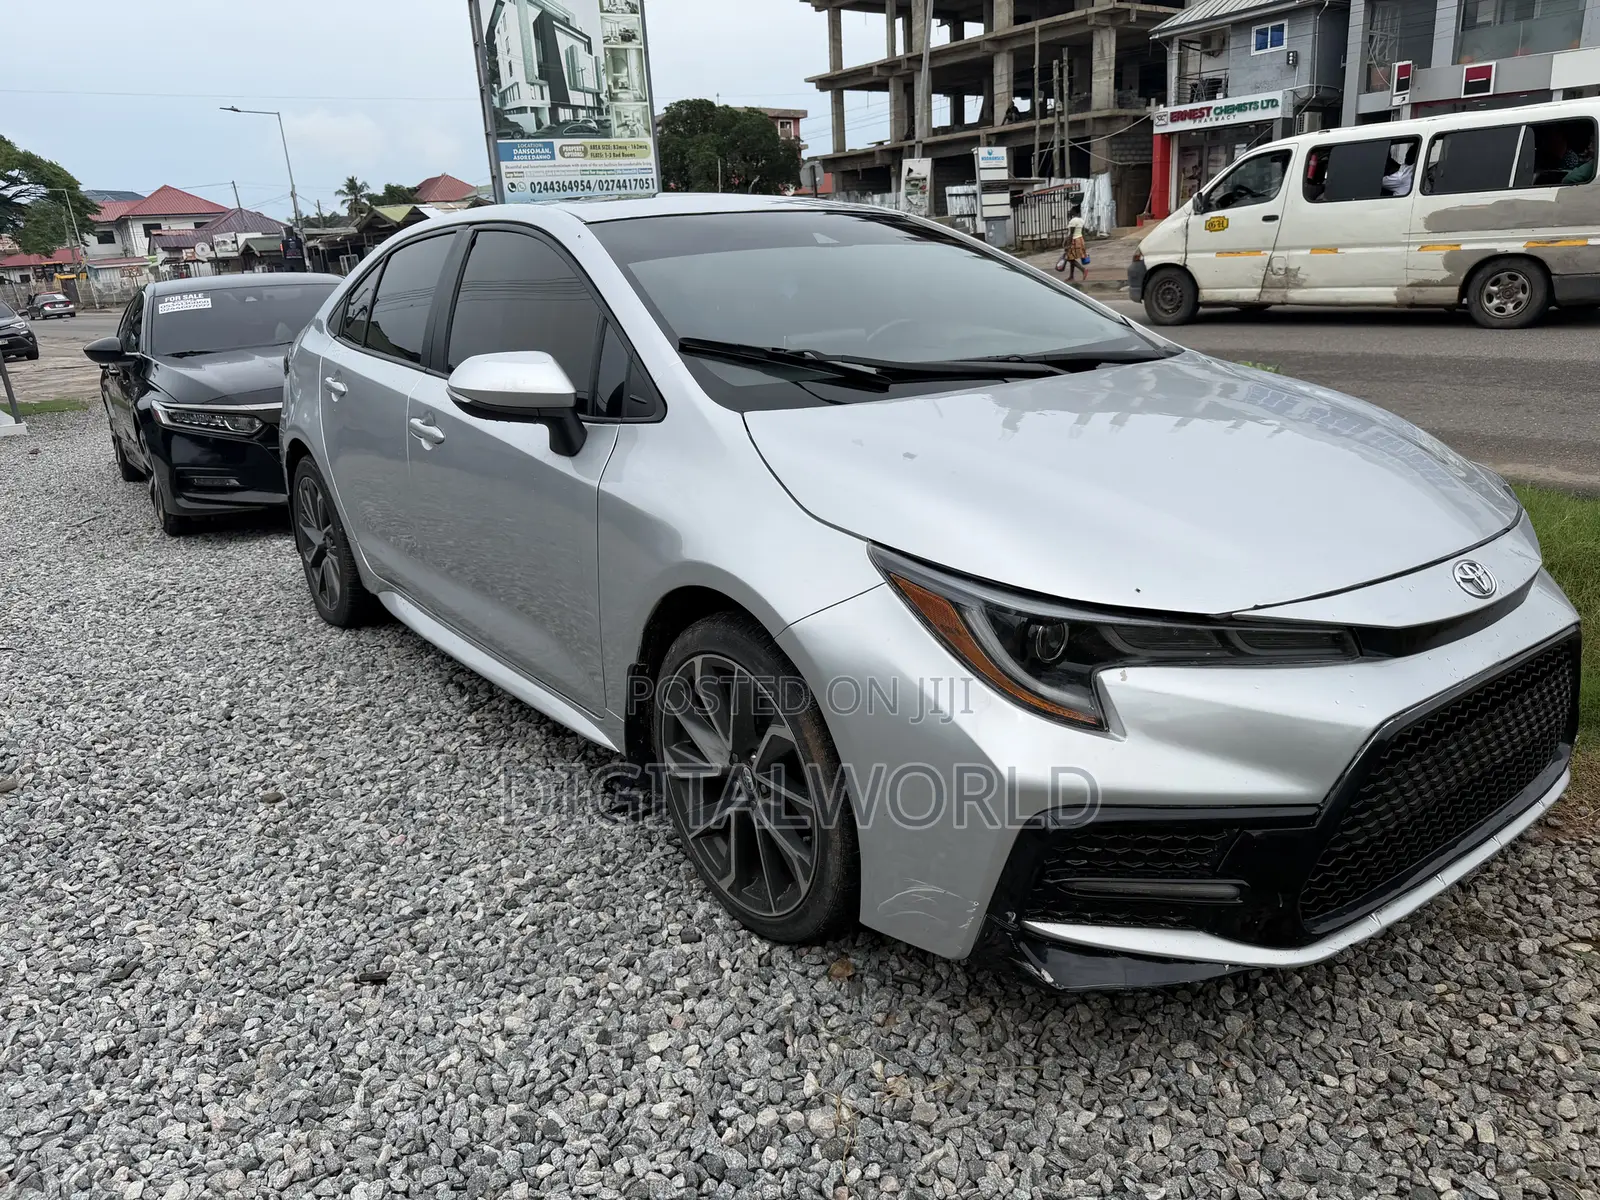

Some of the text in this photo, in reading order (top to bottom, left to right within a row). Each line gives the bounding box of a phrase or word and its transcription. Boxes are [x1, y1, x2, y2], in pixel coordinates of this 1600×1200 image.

[1170, 107, 1212, 123] ERNEST
[1213, 101, 1259, 116] CHEMISTS
[1260, 98, 1280, 110] LTD.
[1193, 114, 1236, 125] PHARMACY
[530, 178, 655, 194] 0244364954/0274417051
